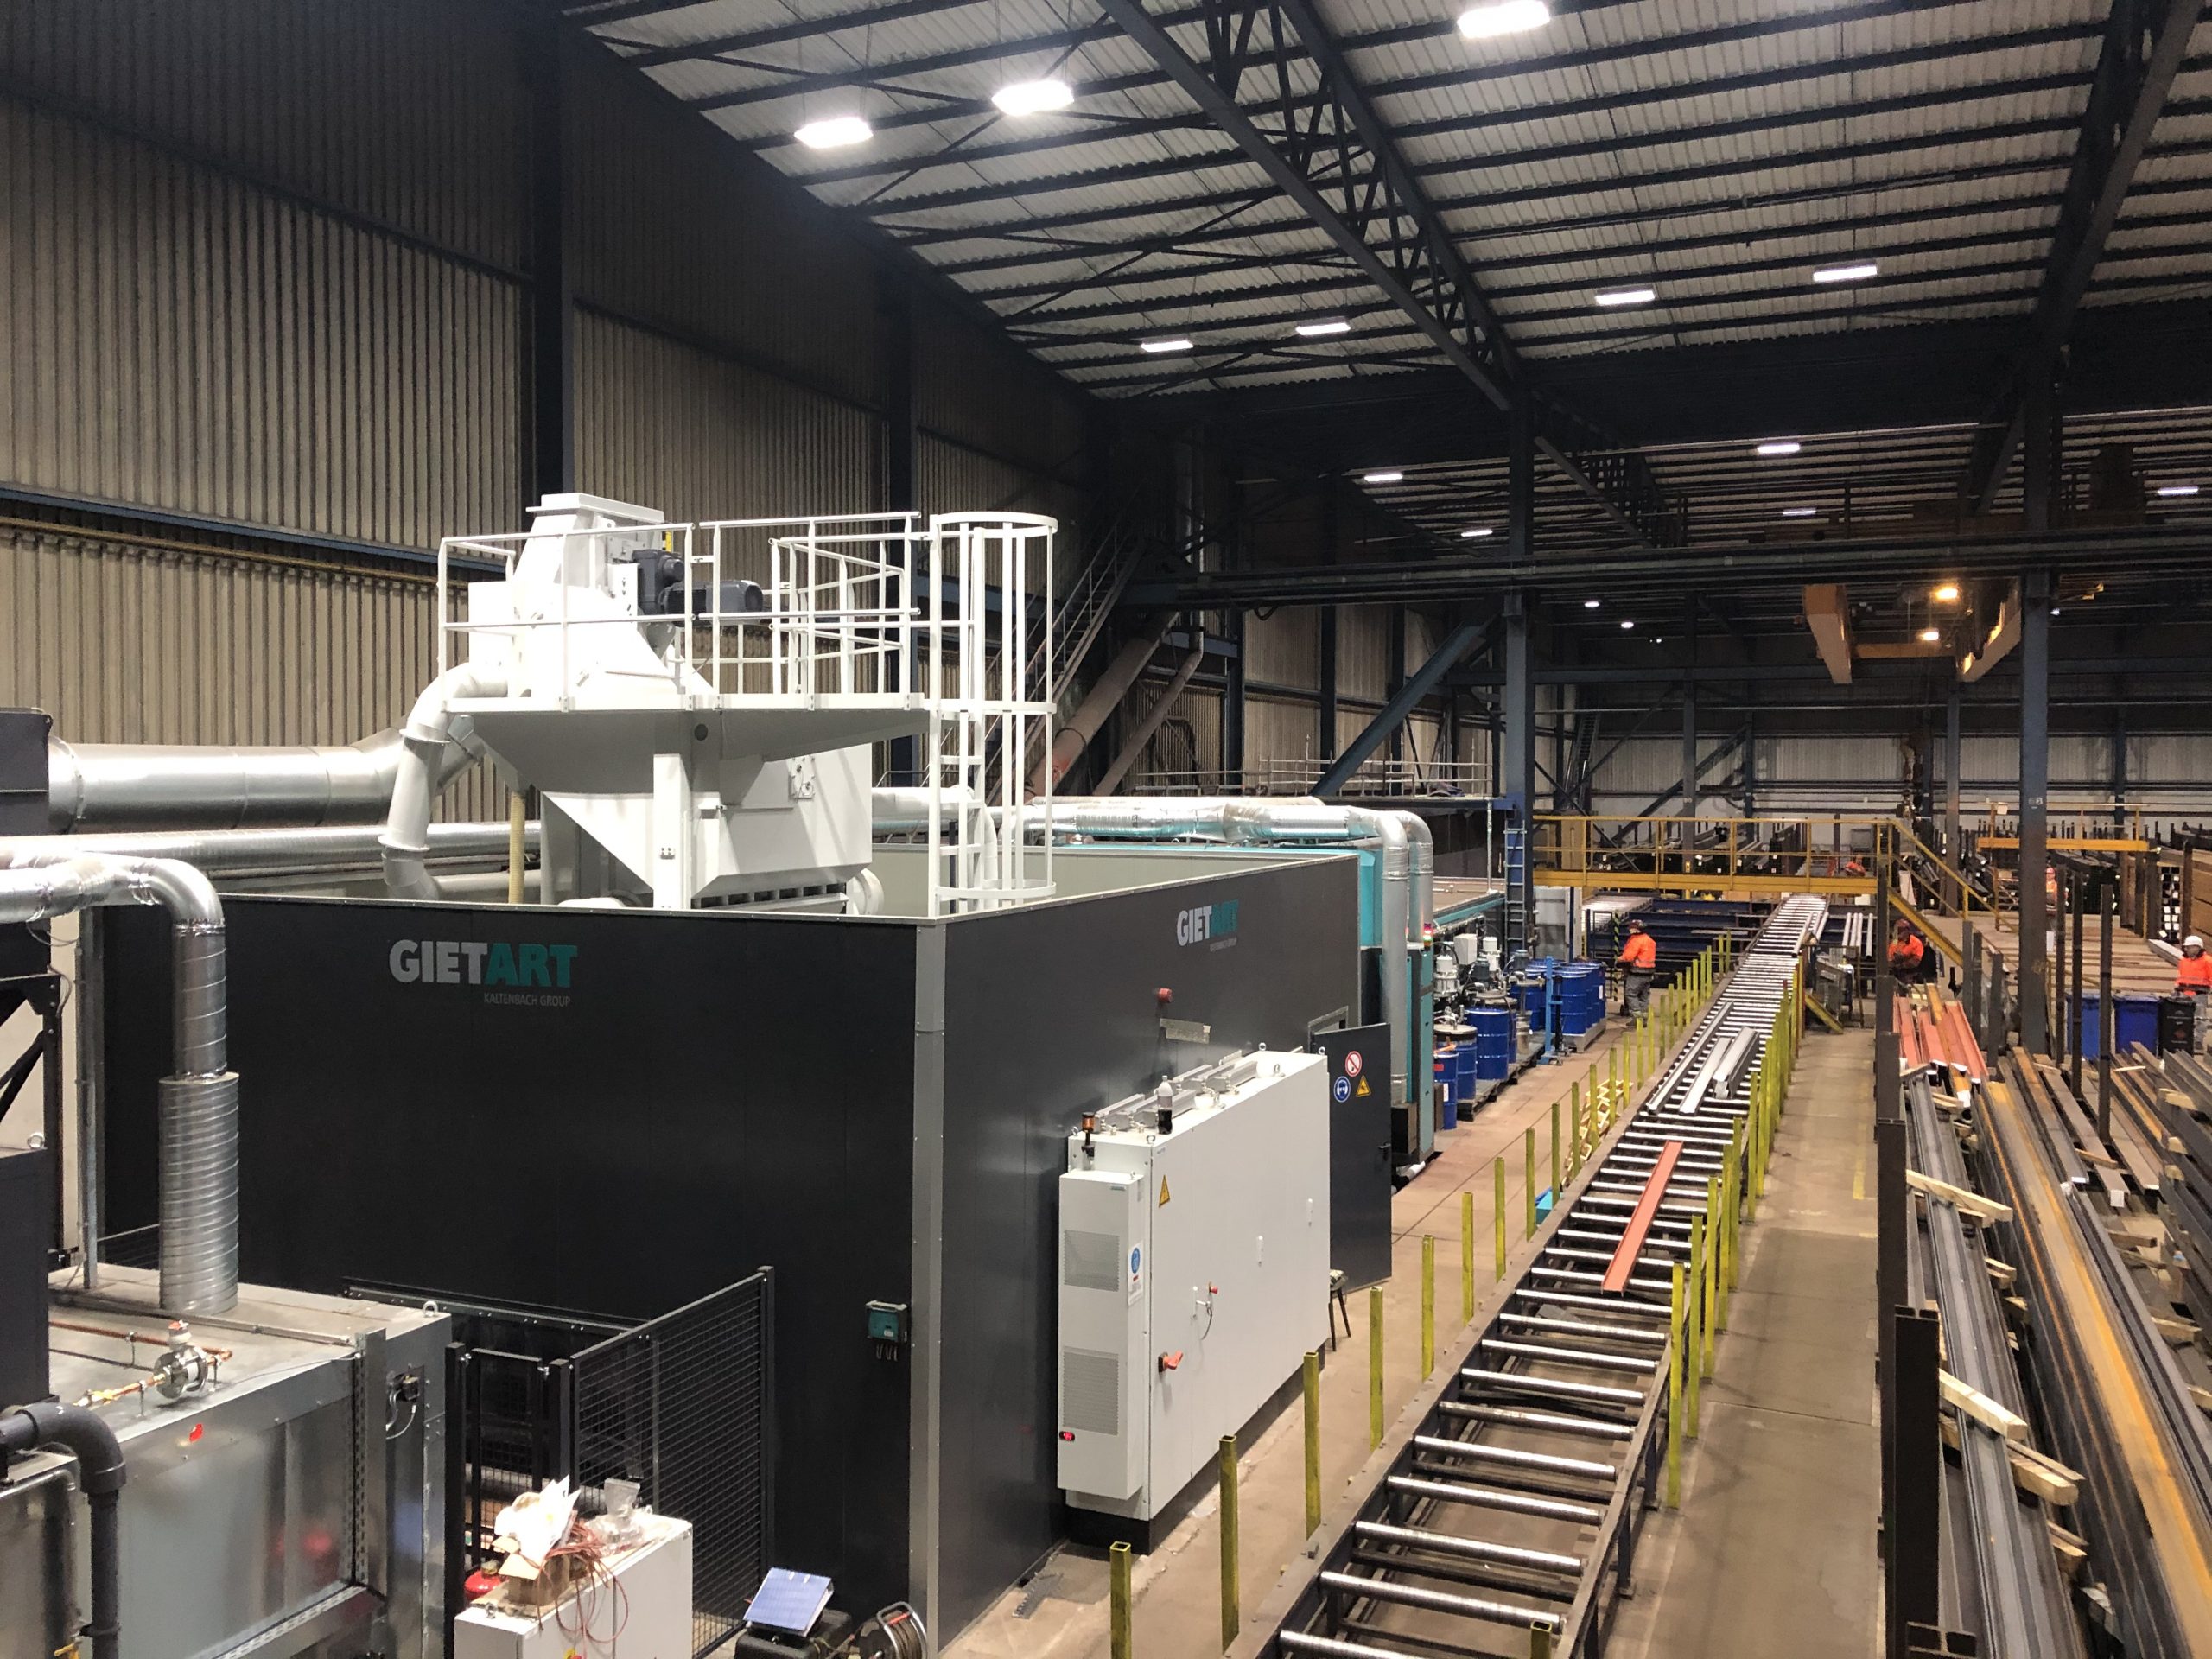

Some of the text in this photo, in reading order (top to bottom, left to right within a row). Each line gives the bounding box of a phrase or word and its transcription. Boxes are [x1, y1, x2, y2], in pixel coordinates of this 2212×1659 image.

[389, 939, 578, 988] GIETART
[483, 992, 571, 1007] KALTENBACH GROUP
